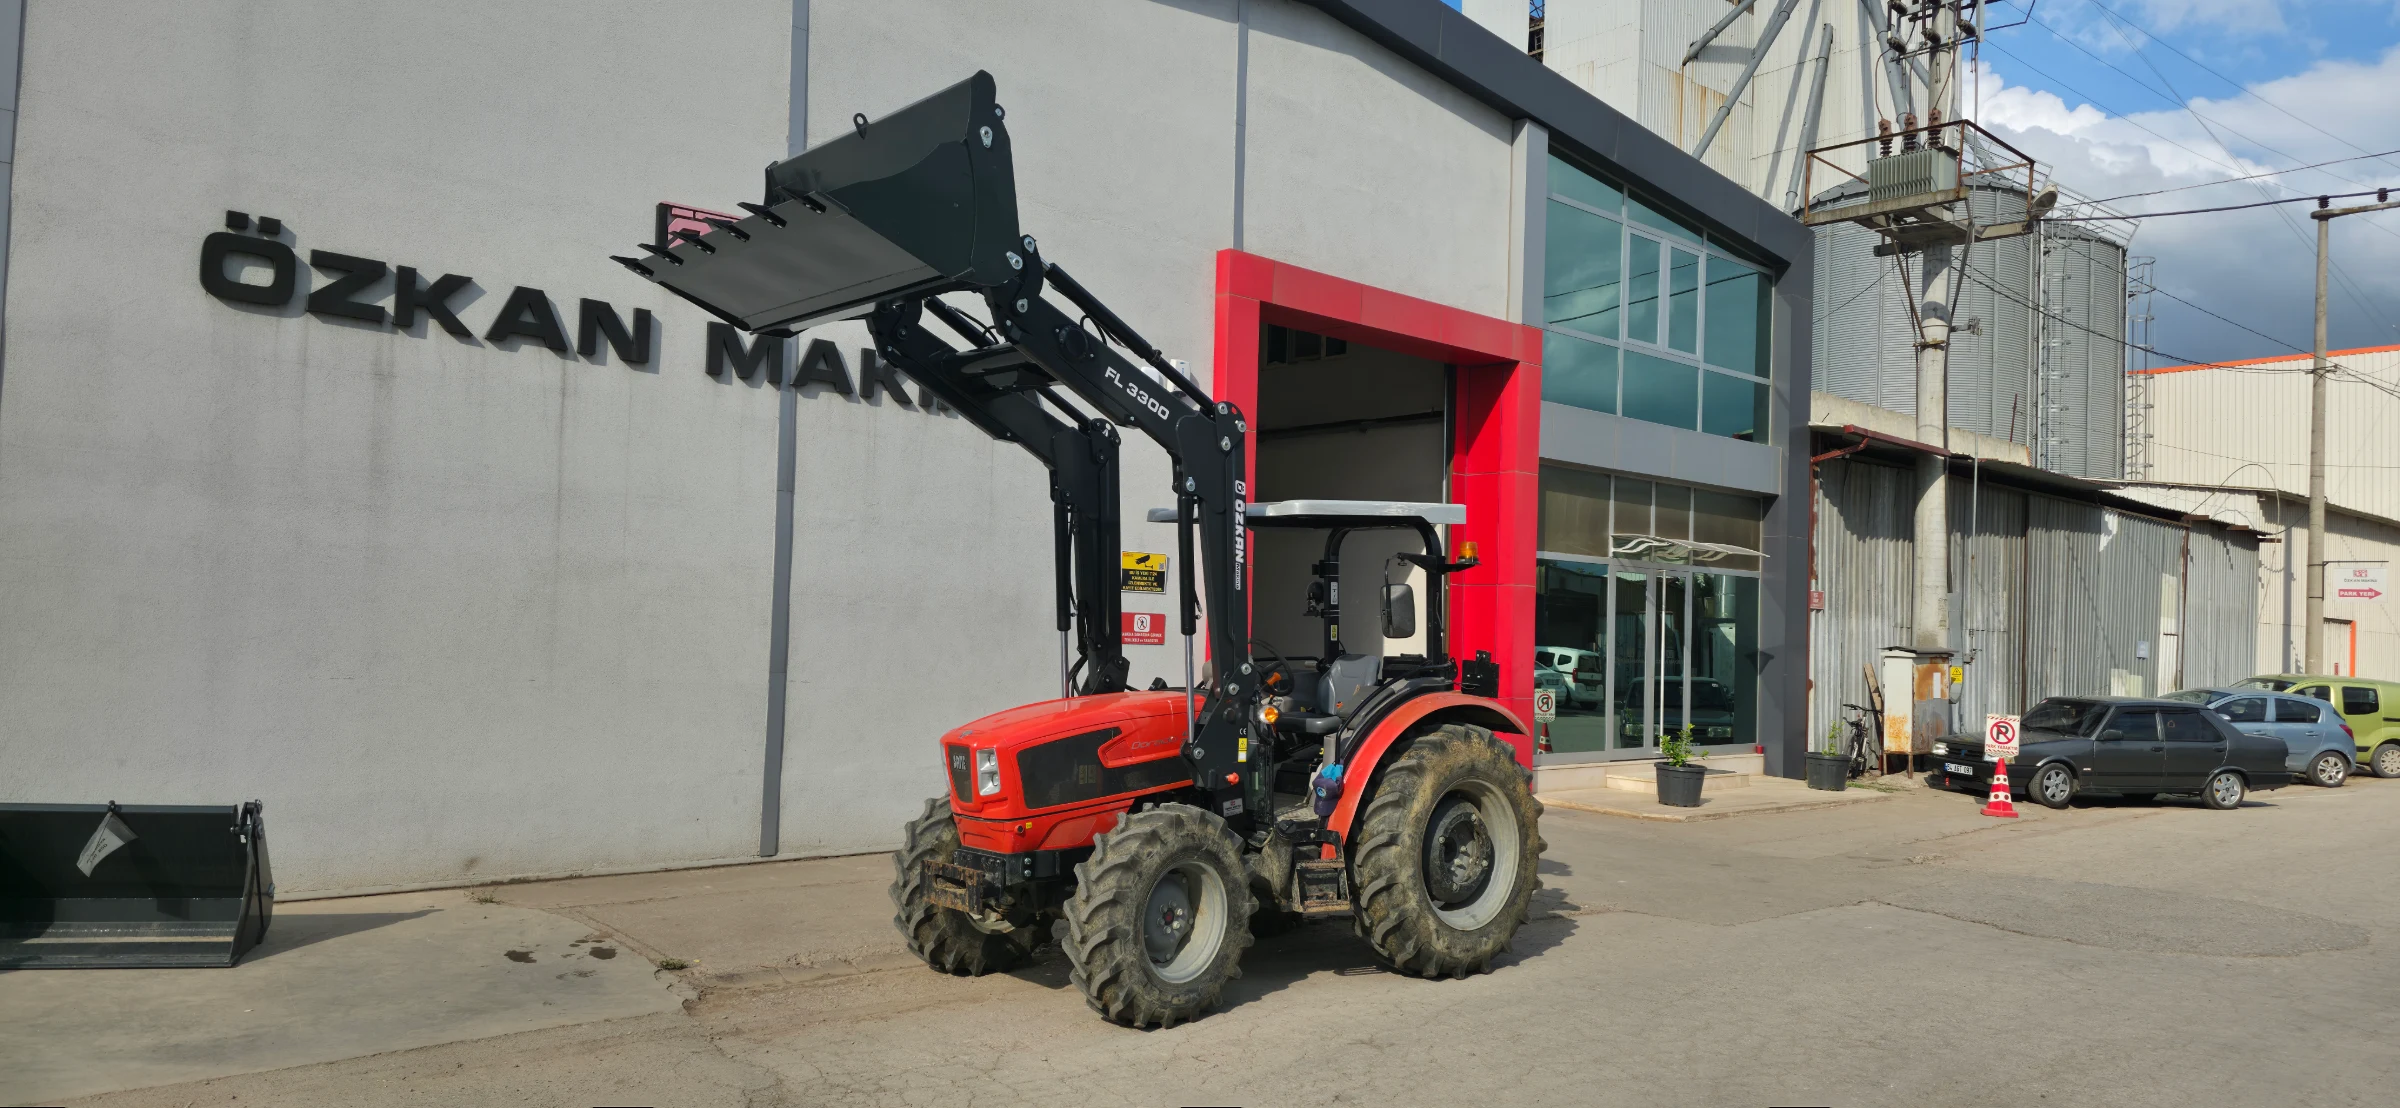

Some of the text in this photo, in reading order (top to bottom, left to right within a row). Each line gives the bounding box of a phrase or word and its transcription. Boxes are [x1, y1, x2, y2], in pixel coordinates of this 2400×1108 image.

[200, 210, 651, 363] ÖZKAN
[1105, 366, 1170, 421] FL 3300
[1235, 498, 1246, 564] ÖZKAN
[1996, 725, 2009, 740] P
